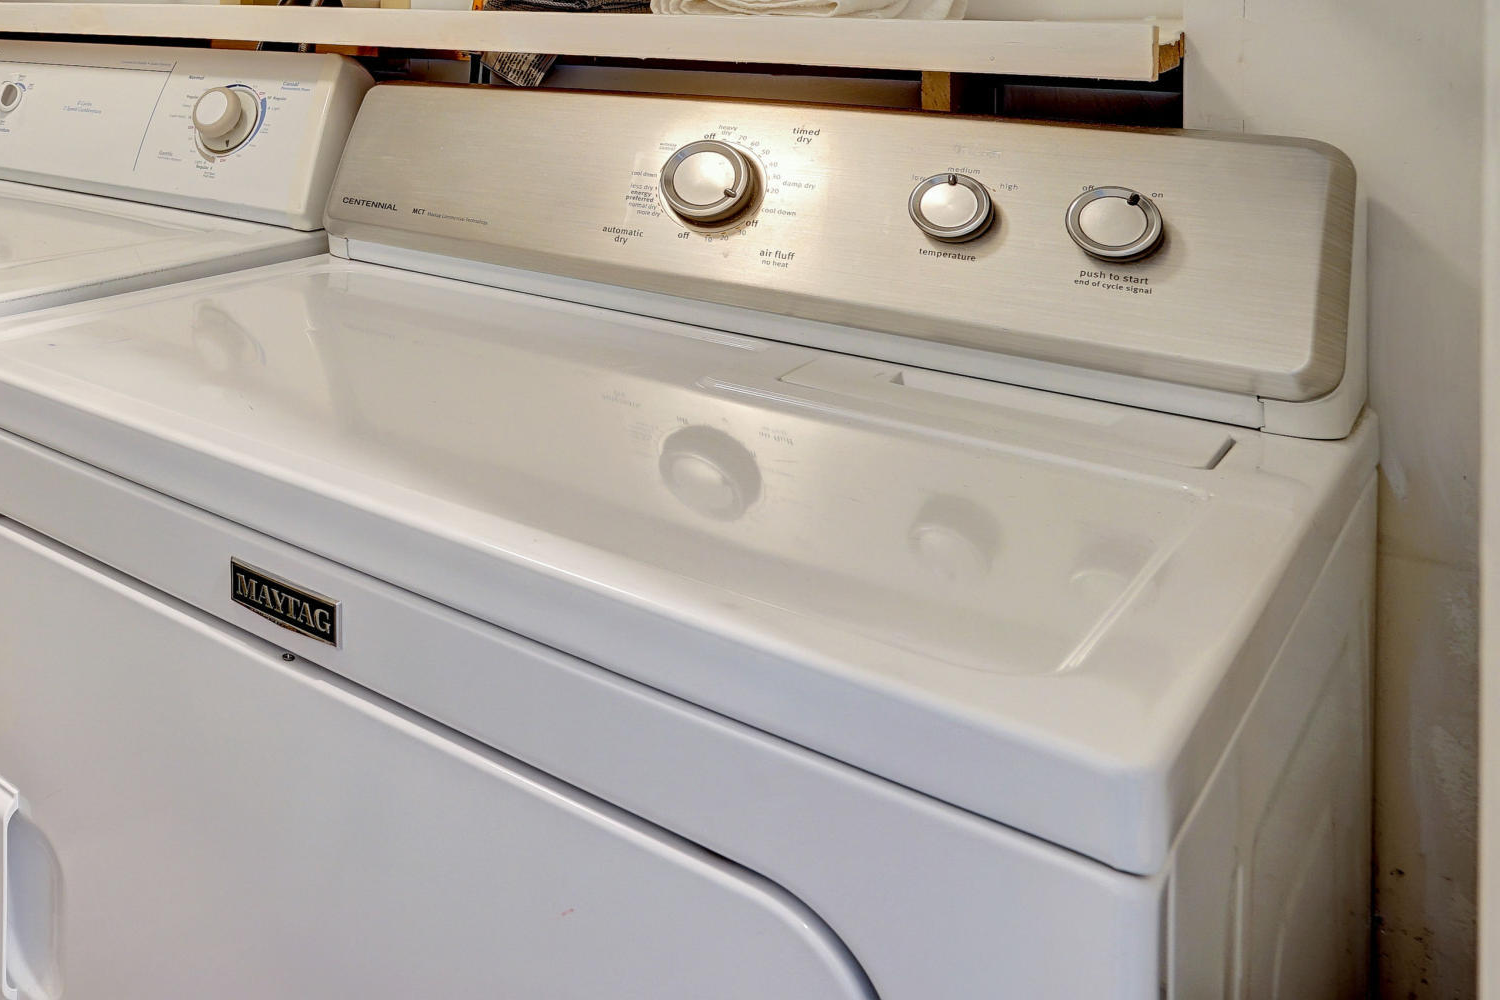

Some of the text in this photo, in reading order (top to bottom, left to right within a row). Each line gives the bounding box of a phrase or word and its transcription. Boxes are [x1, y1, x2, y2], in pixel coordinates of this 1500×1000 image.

[719, 124, 738, 132] heavy
[792, 127, 821, 136] timed
[703, 132, 716, 140] off
[796, 135, 813, 145] dry
[947, 166, 981, 175] medium
[782, 179, 817, 190] damp dry
[999, 183, 1020, 192] high
[1082, 184, 1096, 192] off
[625, 195, 654, 203] preferred
[630, 190, 652, 198] energy
[342, 197, 427, 216] CENTENNIAL MCT
[761, 206, 797, 217] cool down
[745, 219, 759, 228] off
[602, 226, 644, 238] automatic
[677, 231, 691, 240] off
[614, 235, 628, 245] dry
[759, 249, 795, 261] air fluff
[919, 248, 977, 262] temperature
[761, 258, 789, 268] no heat
[1079, 269, 1149, 285] push to start
[1092, 279, 1101, 287] of
[1102, 282, 1124, 291] cycle
[1126, 285, 1152, 295] signal
[235, 572, 332, 634] MAYTAG
